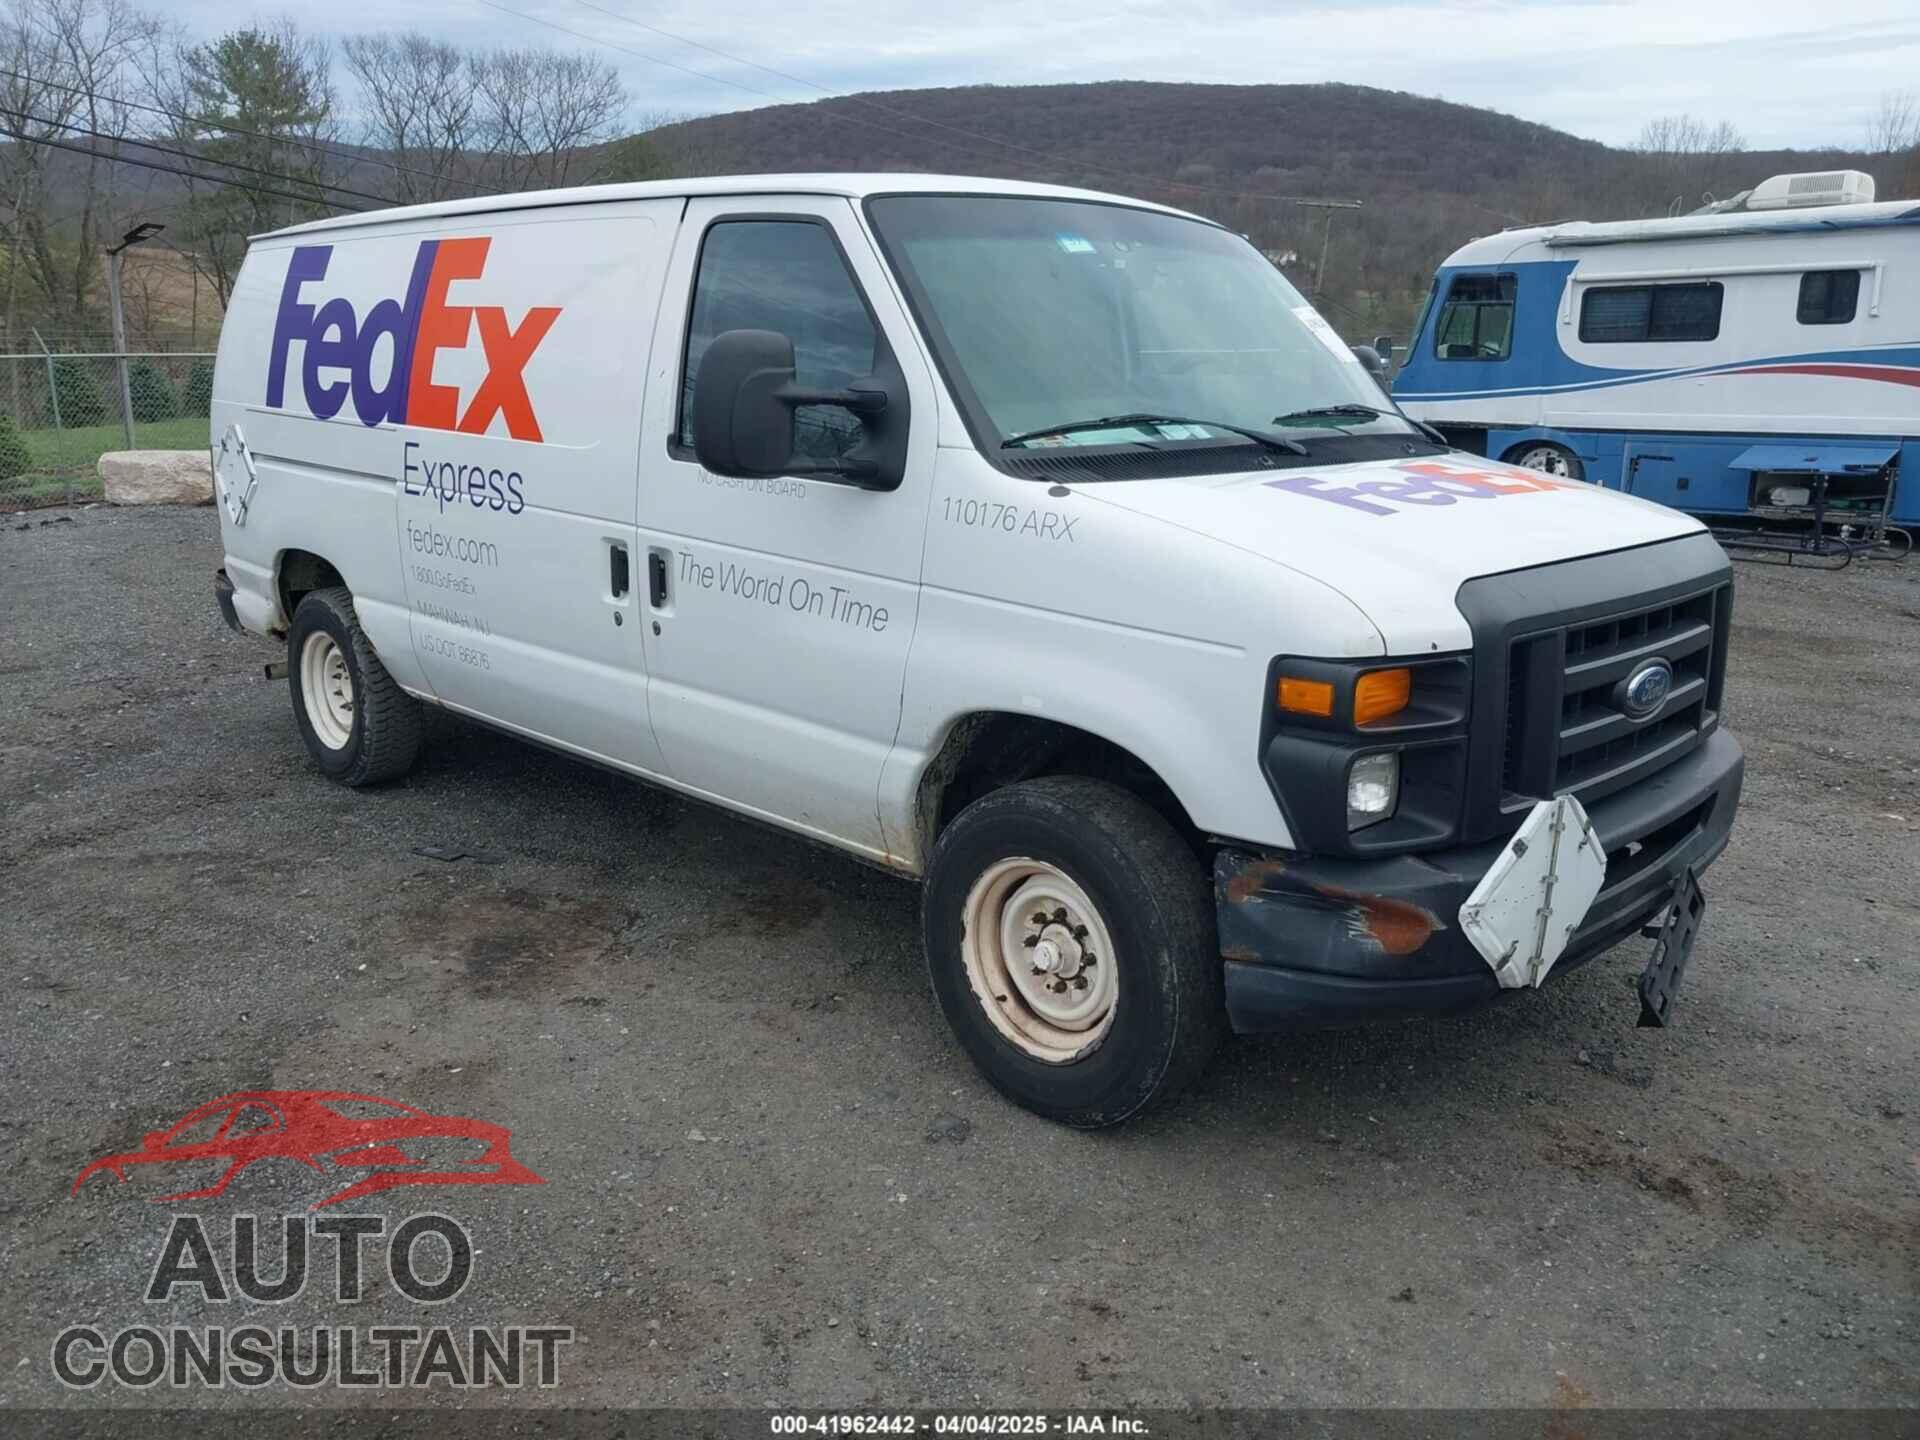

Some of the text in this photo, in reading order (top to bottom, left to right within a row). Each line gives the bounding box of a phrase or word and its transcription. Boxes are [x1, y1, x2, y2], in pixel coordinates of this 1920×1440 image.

[265, 237, 563, 443] FedEx
[404, 441, 525, 515] Express
[766, 480, 807, 498] BOARD
[1261, 464, 1592, 516] FedEx
[406, 519, 499, 567] fedex.com
[943, 496, 1080, 542] 110176 ARX
[678, 551, 889, 632] The World On Time
